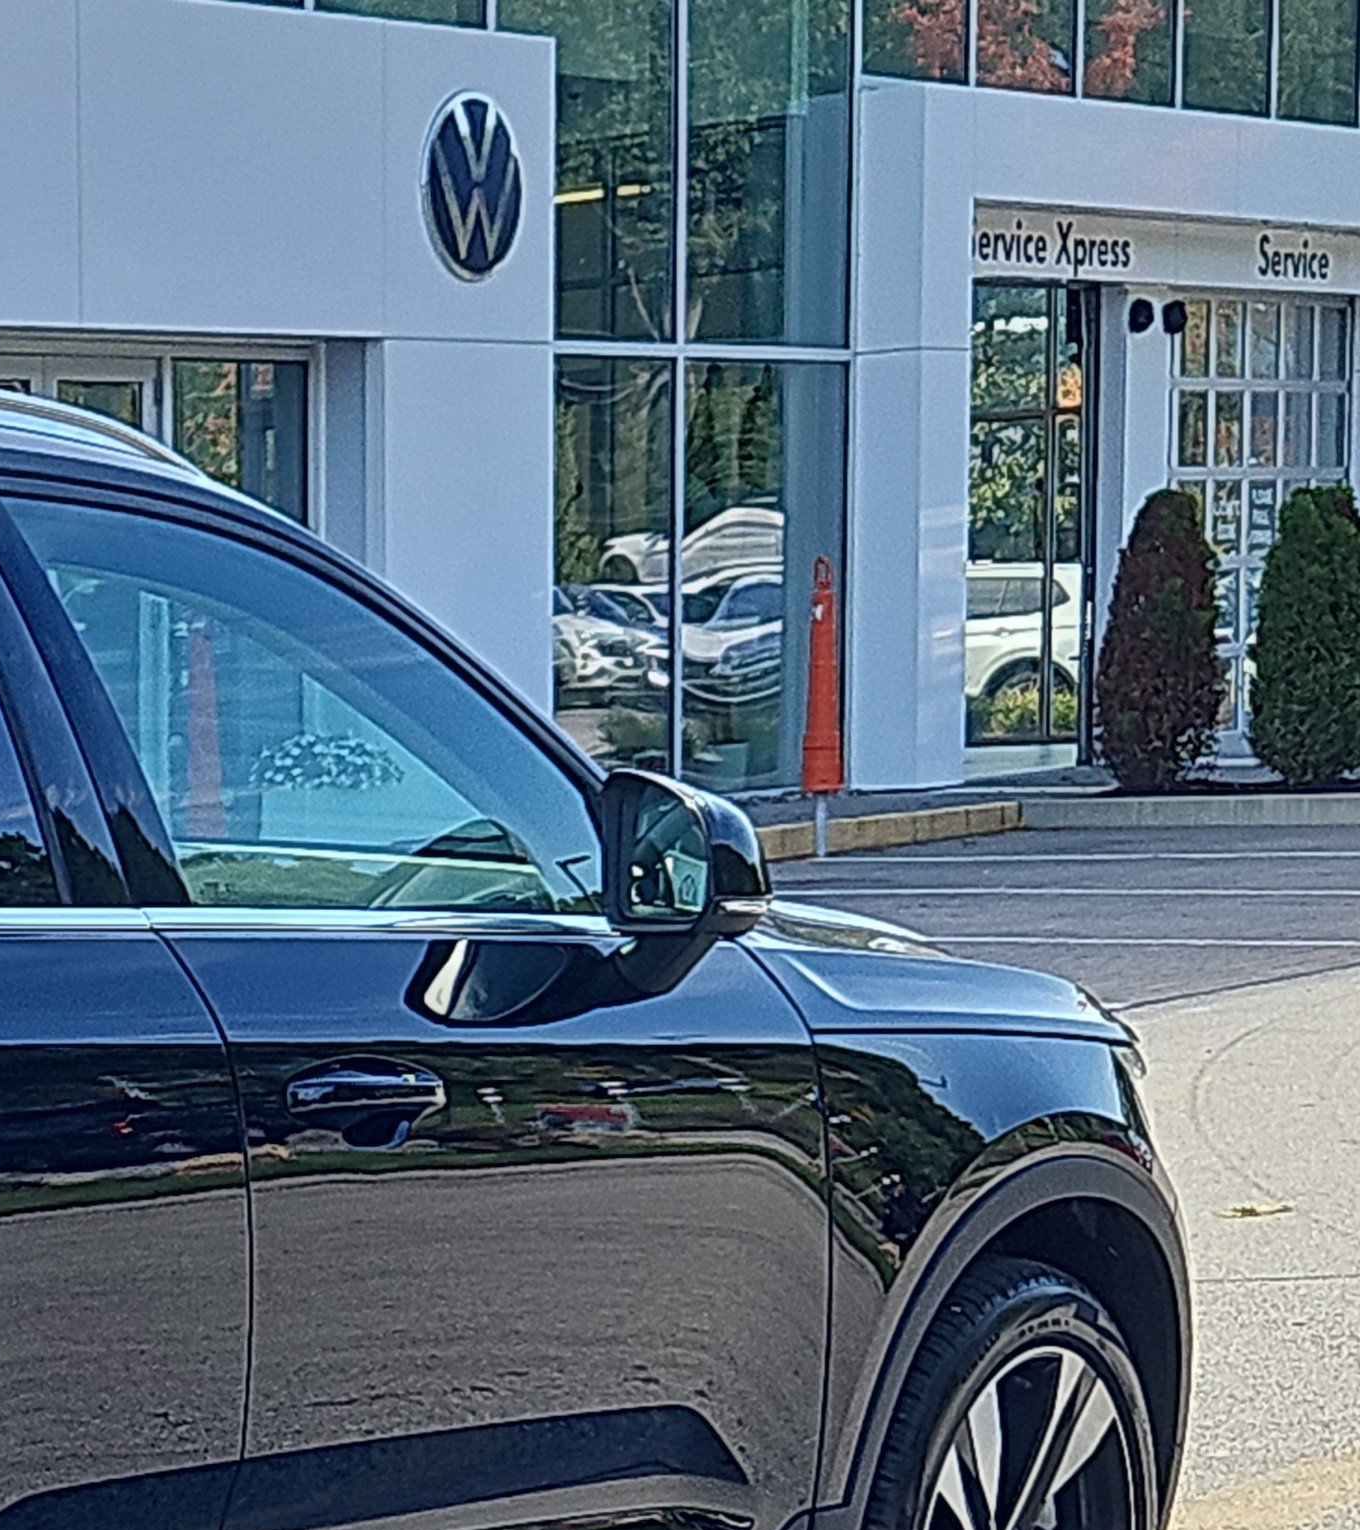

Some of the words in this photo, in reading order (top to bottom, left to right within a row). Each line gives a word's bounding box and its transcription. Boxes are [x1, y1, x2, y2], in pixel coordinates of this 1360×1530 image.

[972, 219, 1047, 264] ervice
[1055, 220, 1131, 277] Xpress
[1258, 234, 1329, 280] Service
